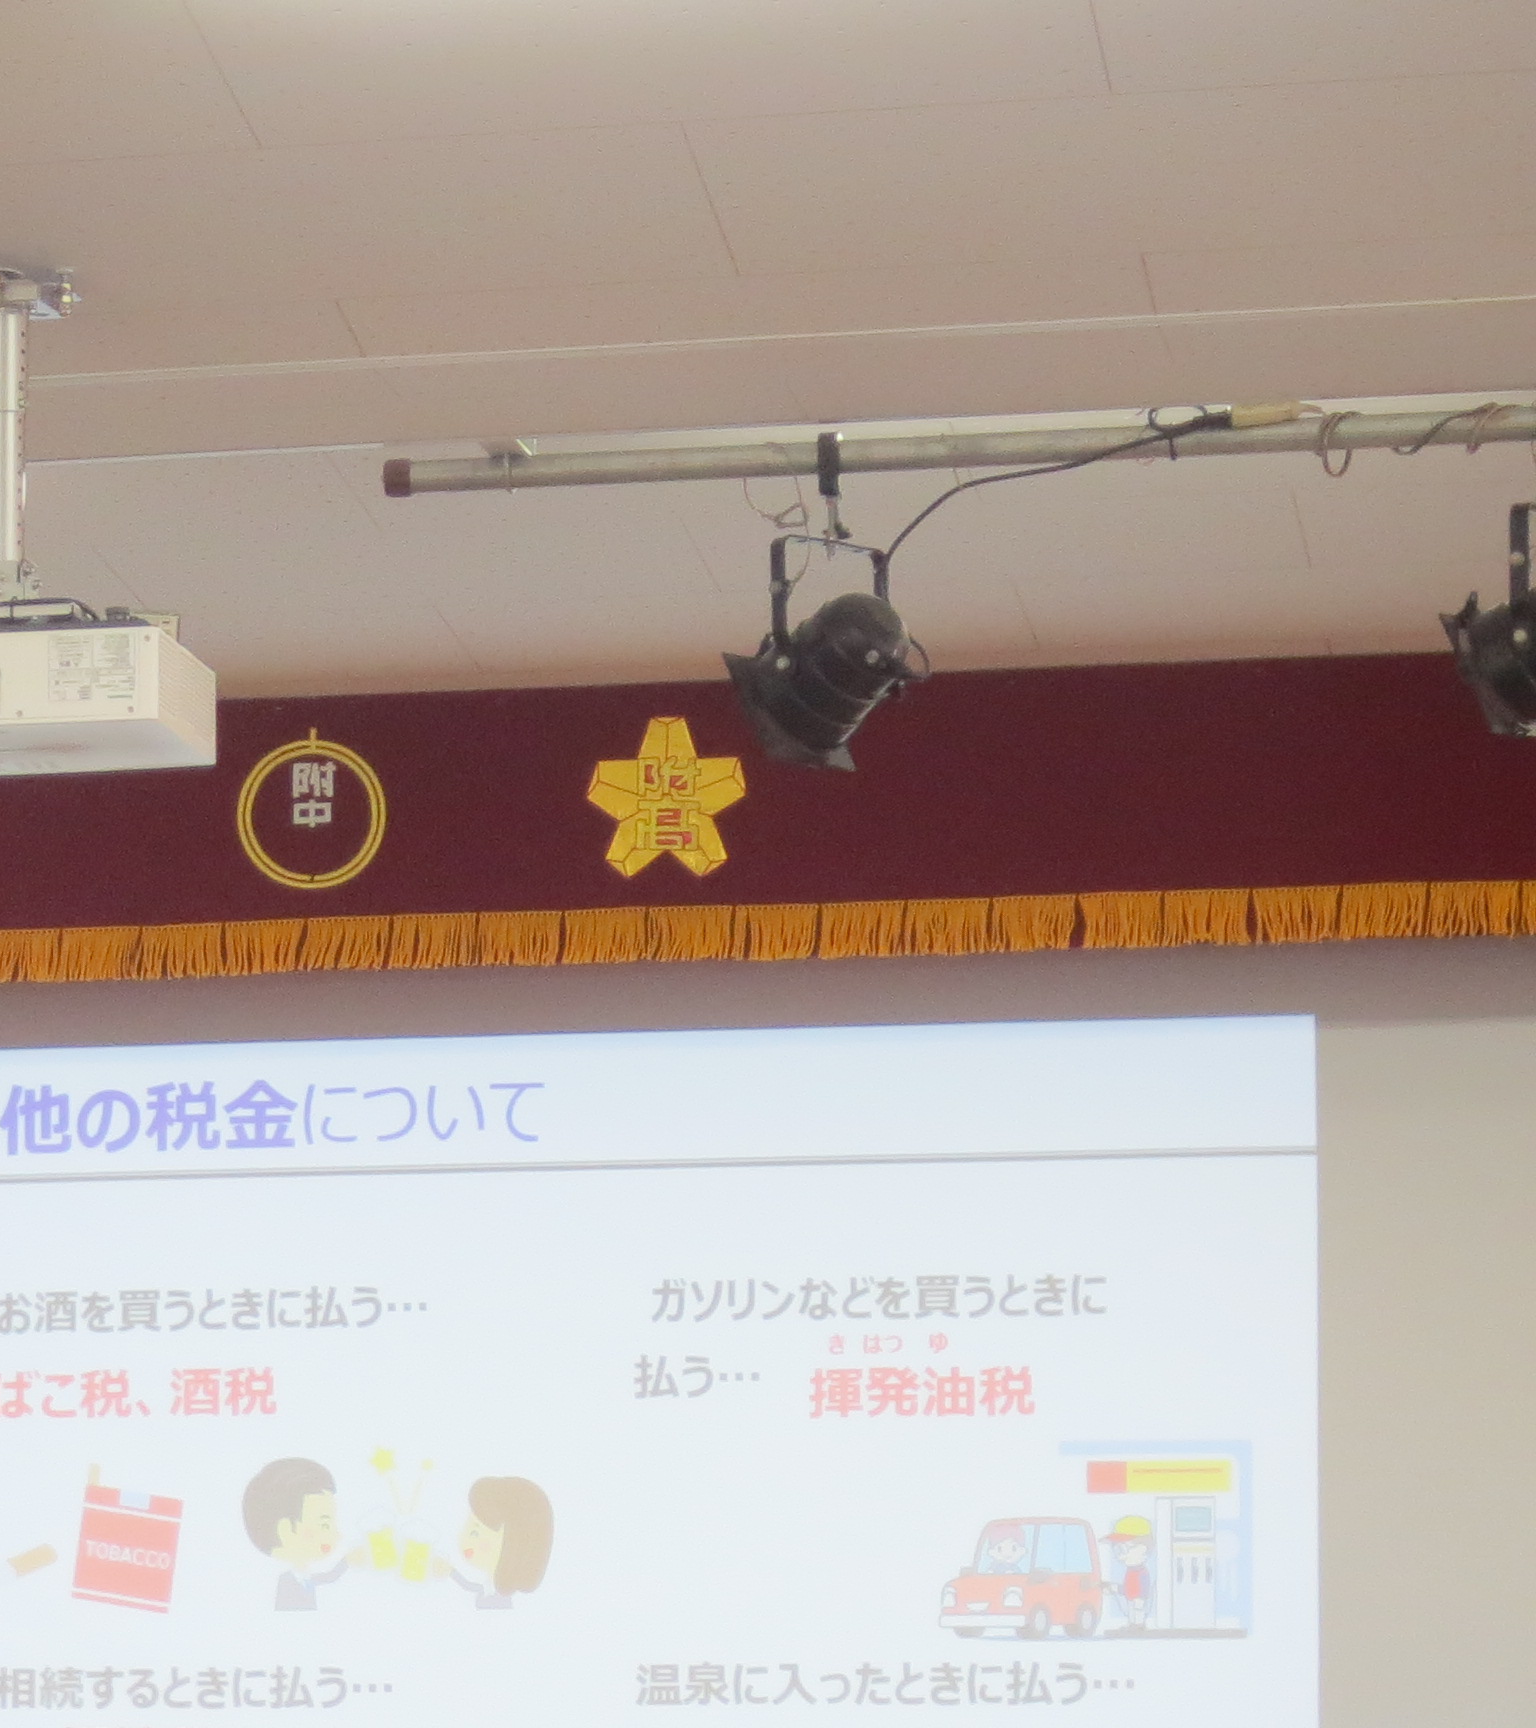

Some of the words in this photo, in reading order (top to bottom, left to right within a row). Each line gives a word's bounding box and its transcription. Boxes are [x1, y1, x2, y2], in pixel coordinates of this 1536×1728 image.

[292, 761, 337, 828] 附中
[636, 756, 701, 850] 附高
[651, 1274, 1108, 1323] ガソリンなどを買うときに
[809, 1366, 1036, 1418] 揮発油税
[85, 1539, 171, 1570] TOBACCO
